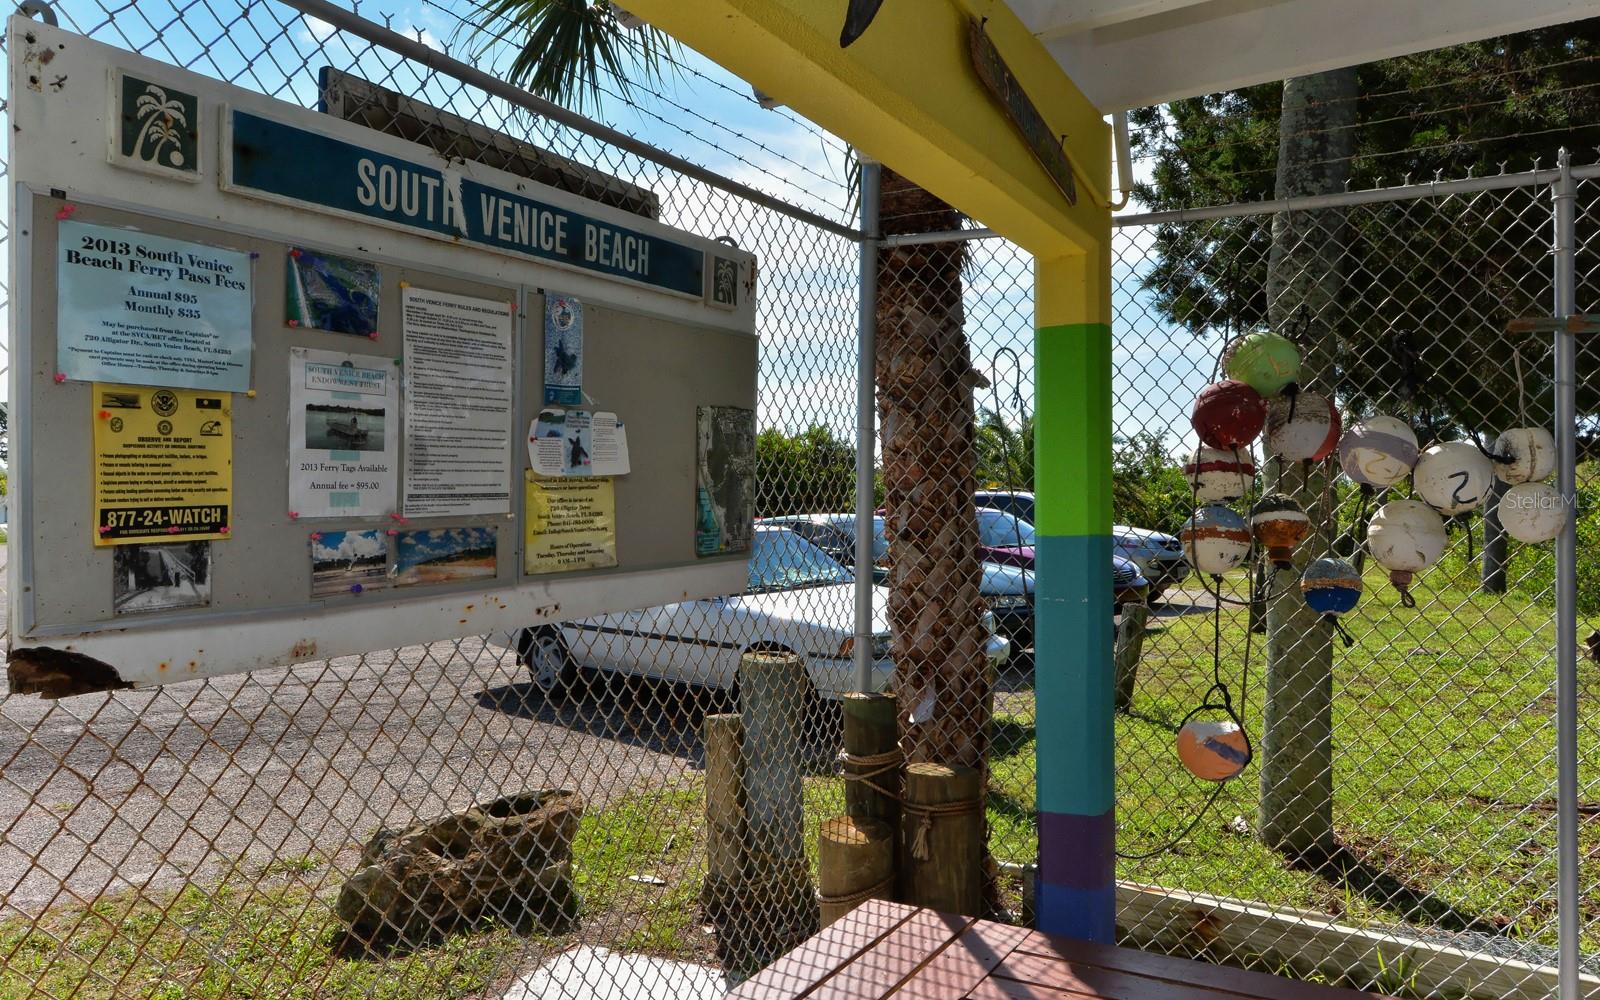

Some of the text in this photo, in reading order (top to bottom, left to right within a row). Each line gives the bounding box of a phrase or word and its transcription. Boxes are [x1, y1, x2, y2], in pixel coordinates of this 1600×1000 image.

[356, 158, 649, 276] SOUTH VENICE BEACH
[81, 236, 233, 274] 2013 South Venice
[66, 250, 246, 290] Beach Ferry Pass Fees
[128, 286, 198, 304] Annual $95
[124, 300, 200, 320] Monthly $35
[126, 324, 158, 332] purchased
[101, 336, 129, 344] Alligator
[308, 366, 332, 375] SOUTH
[362, 372, 384, 380] BEACH
[300, 463, 387, 474] 2013 Ferry Tags Available
[310, 482, 337, 490] Annual
[356, 482, 379, 490] $95.00
[1448, 471, 1478, 504] 2
[108, 508, 220, 527] 877-24-WATCH
